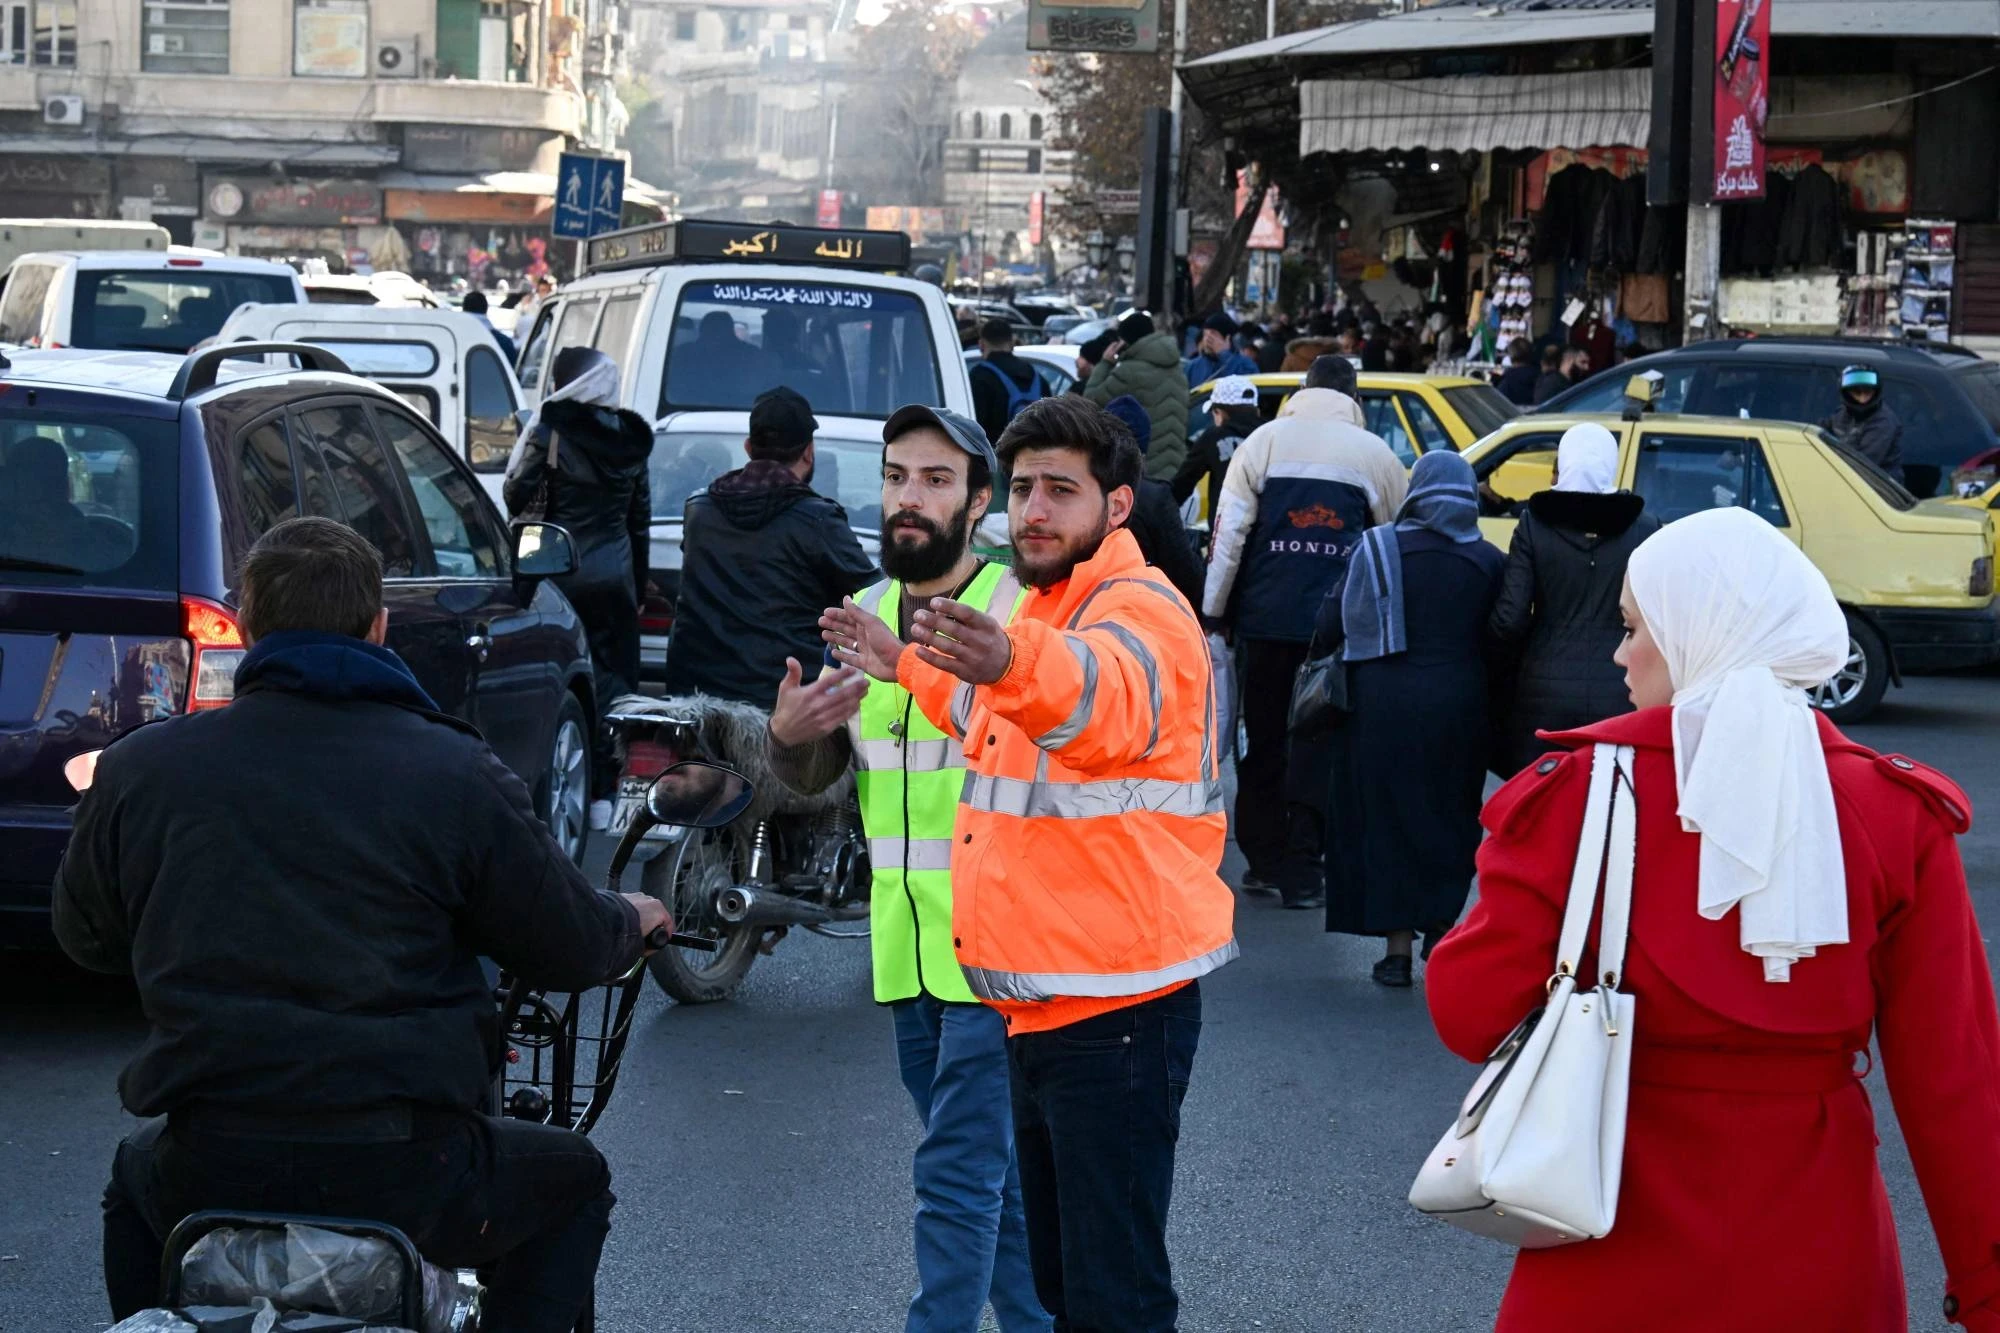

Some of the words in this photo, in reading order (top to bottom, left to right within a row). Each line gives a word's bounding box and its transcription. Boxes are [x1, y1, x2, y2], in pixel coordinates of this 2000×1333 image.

[815, 238, 863, 258] الله
[714, 284, 740, 299] الله
[799, 289, 824, 304] الله
[860, 292, 872, 308] لا
[1270, 540, 1351, 556] HONDA
